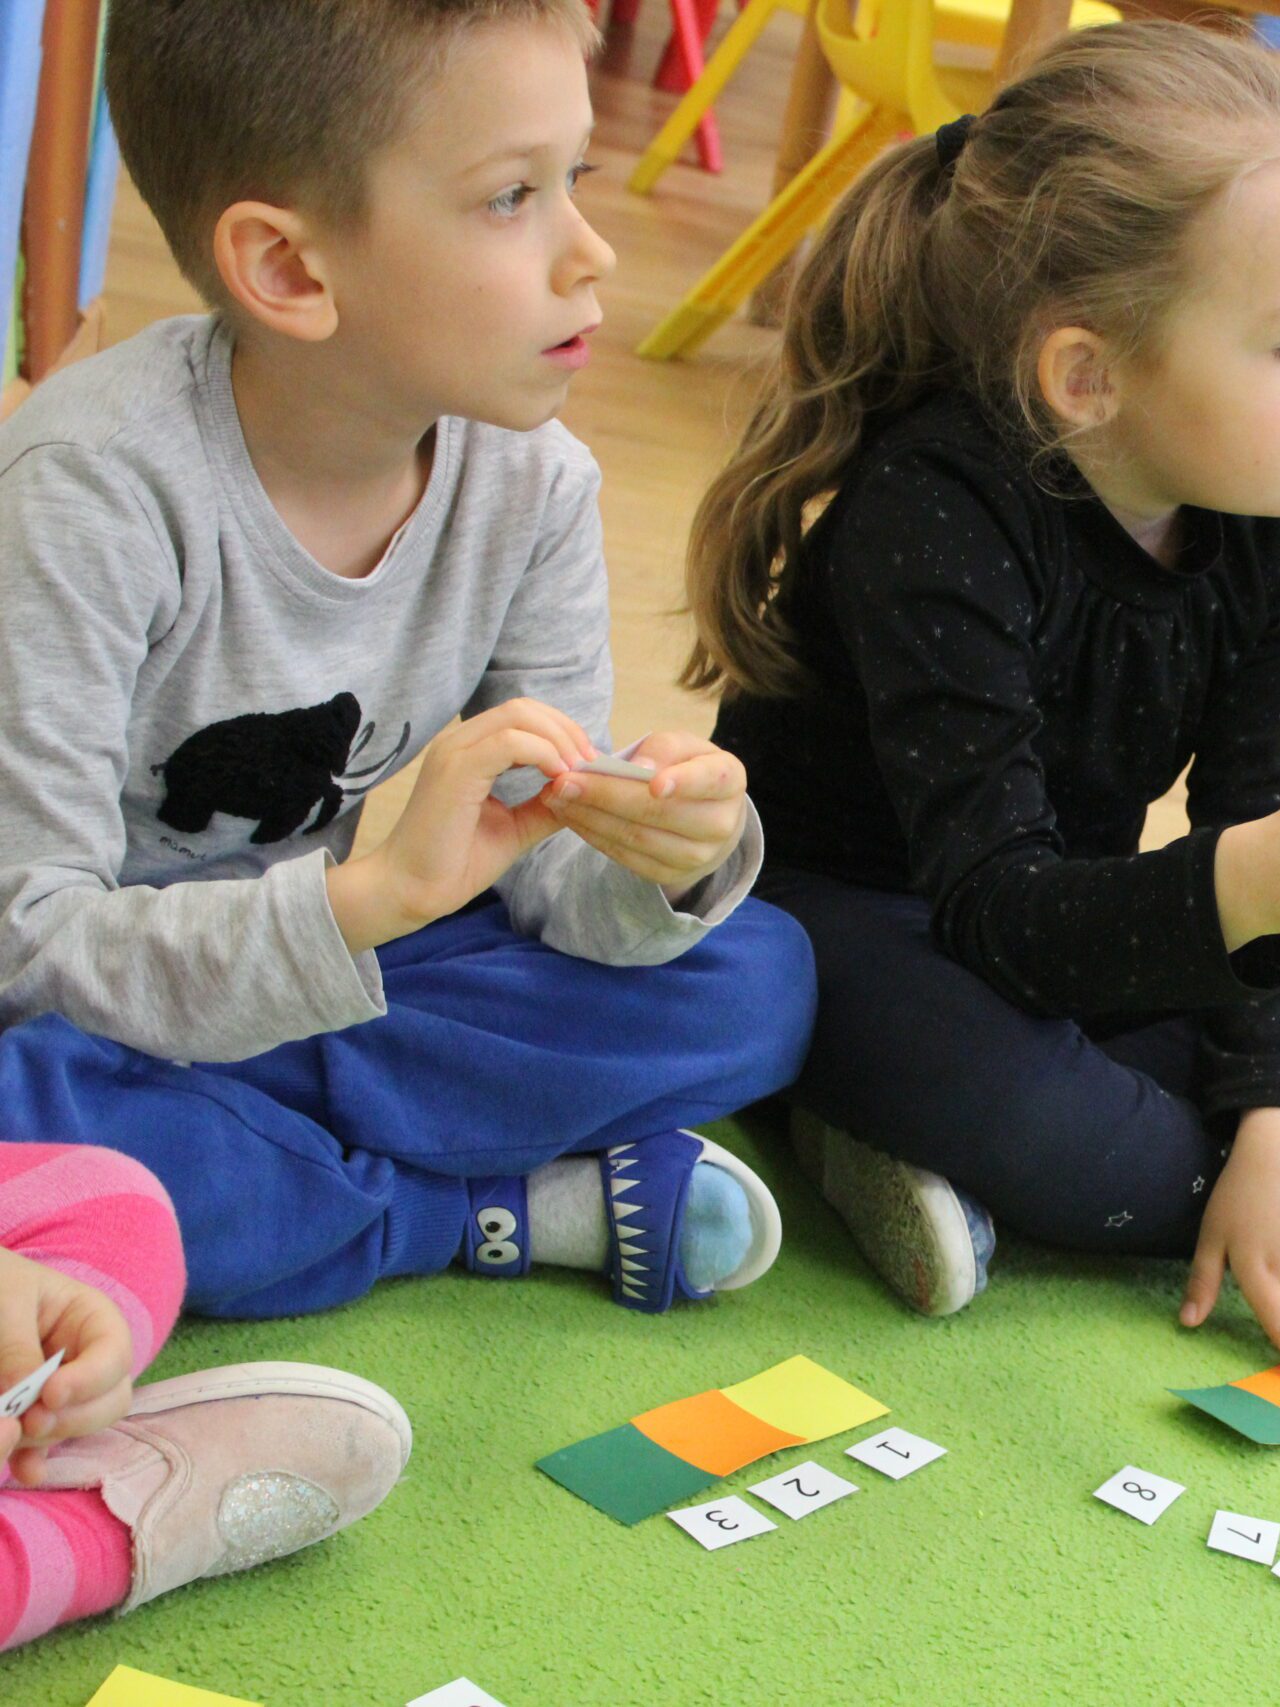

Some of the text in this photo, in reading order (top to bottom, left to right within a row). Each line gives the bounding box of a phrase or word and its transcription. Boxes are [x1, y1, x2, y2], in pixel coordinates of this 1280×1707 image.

[876, 1440, 911, 1461] 1
[782, 1476, 820, 1498] 2
[1121, 1480, 1157, 1502] 8
[704, 1509, 740, 1532] 3
[1226, 1525, 1263, 1546] 7
